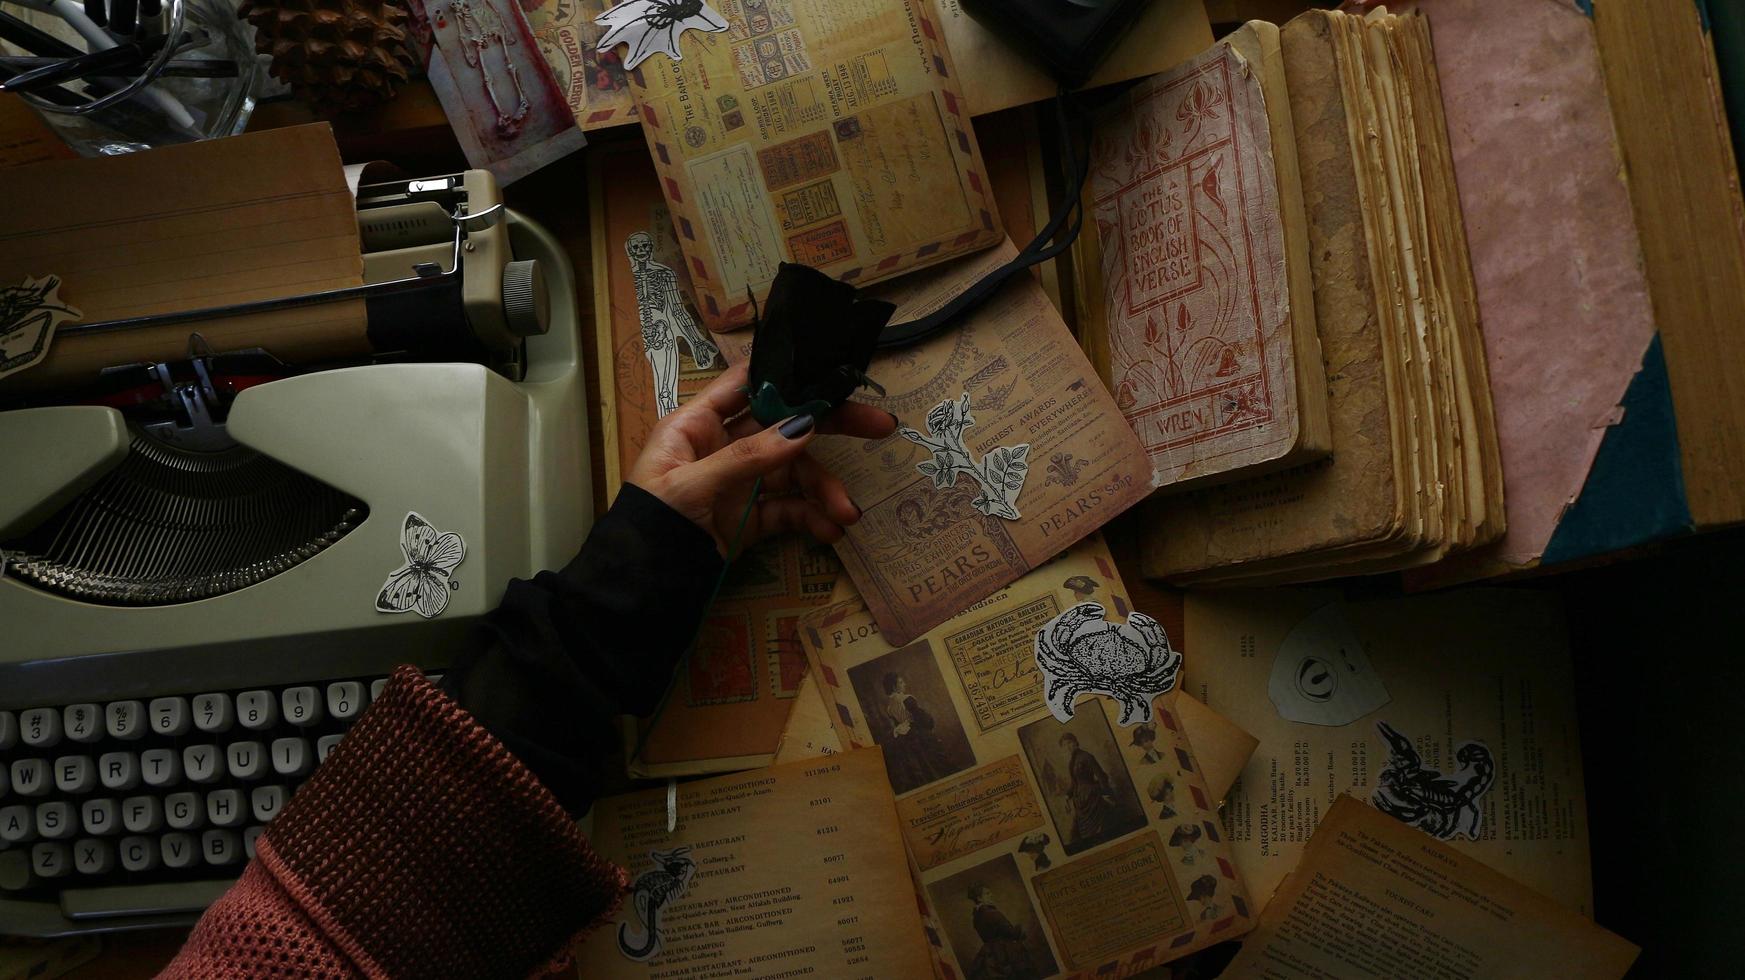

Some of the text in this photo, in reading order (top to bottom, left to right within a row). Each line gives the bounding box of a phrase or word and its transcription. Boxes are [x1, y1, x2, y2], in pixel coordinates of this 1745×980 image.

[560, 29, 588, 112] GOLDEN CHERRY
[675, 75, 689, 102] BANK
[684, 104, 694, 122] THE
[1129, 193, 1183, 231] LOTUS
[1142, 187, 1163, 202] THE
[1131, 213, 1183, 252] BOOK OF
[1134, 235, 1188, 275] ENGLISH
[1136, 256, 1191, 292] VERSE
[976, 397, 1056, 453] HIGHEST AWARDS
[1156, 408, 1202, 435] WREN
[1103, 470, 1137, 499] Soap
[908, 545, 989, 602] PEARS
[32, 700, 213, 726] # $ % &
[968, 682, 991, 720] 367430
[31, 701, 349, 739] 3 4 5 6 7 8 9 0
[20, 748, 290, 784] W E R T Y U I
[7, 795, 274, 832] A S D F G H J
[1260, 804, 1268, 856] SARGODHA
[41, 839, 224, 867] Z X C V B
